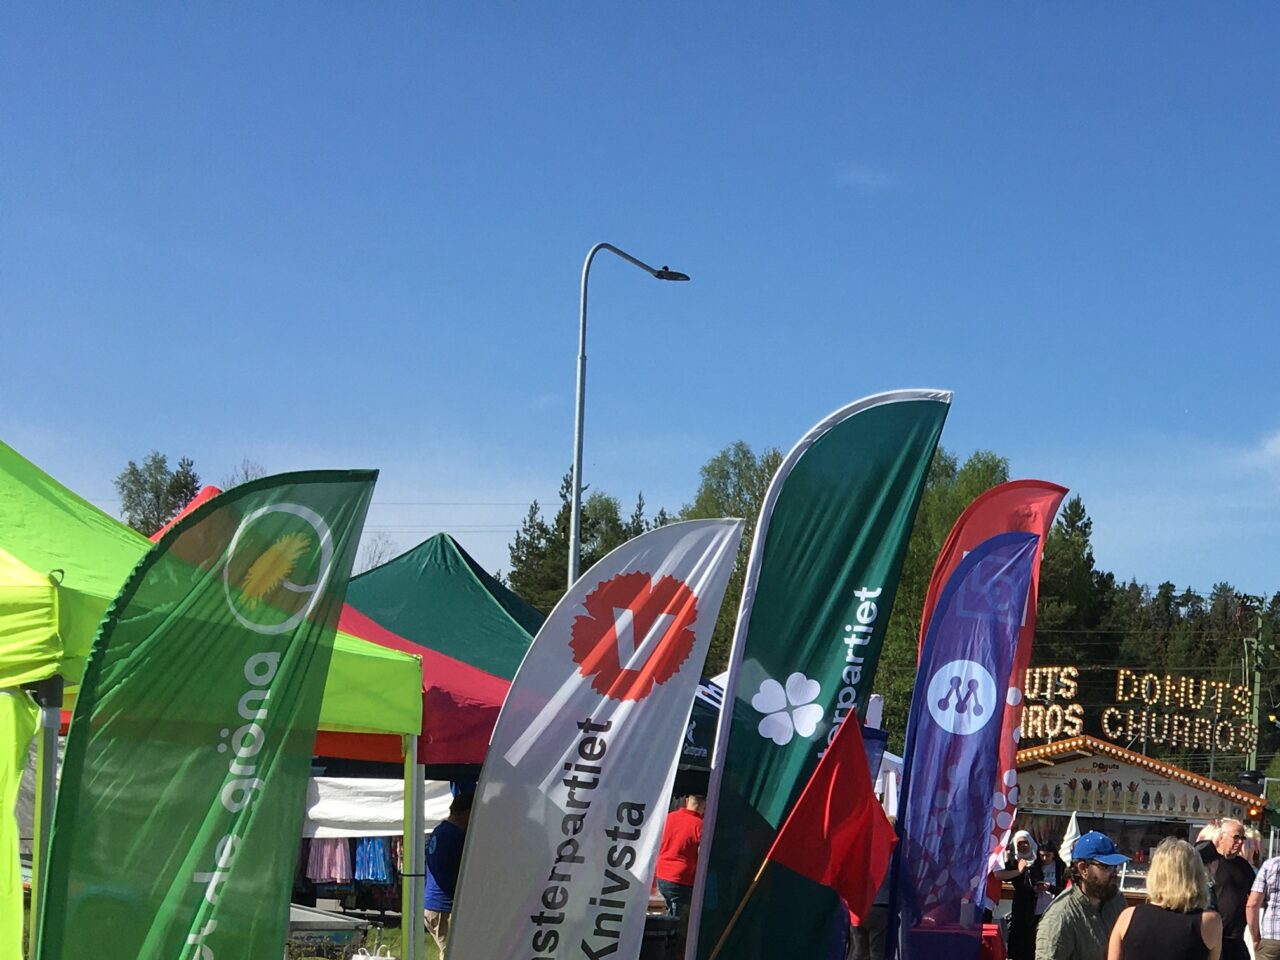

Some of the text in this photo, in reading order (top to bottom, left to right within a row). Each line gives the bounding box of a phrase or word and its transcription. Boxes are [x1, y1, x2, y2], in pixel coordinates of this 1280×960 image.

[818, 586, 883, 758] erpartiet
[1116, 668, 1252, 716] DONUTS
[217, 652, 281, 814] gröna
[1102, 706, 1259, 753] CHURROS
